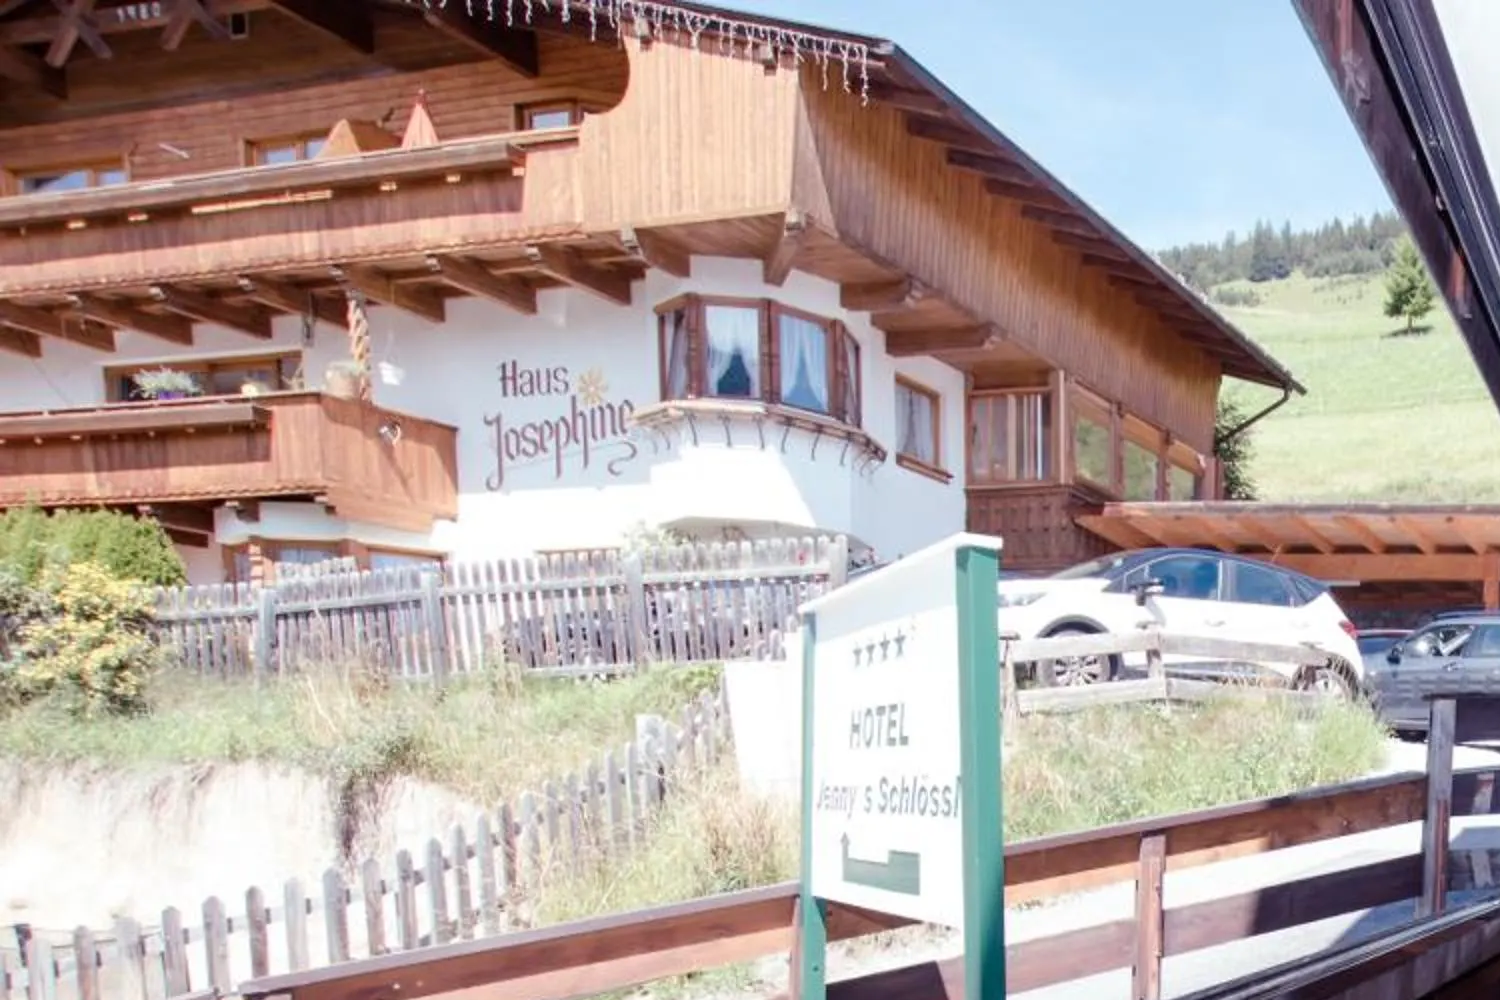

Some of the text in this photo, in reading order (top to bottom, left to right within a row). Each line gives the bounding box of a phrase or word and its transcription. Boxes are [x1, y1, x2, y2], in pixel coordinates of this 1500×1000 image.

[498, 359, 570, 397] Haus
[483, 395, 636, 492] Josephine
[849, 702, 910, 749] HOTEL
